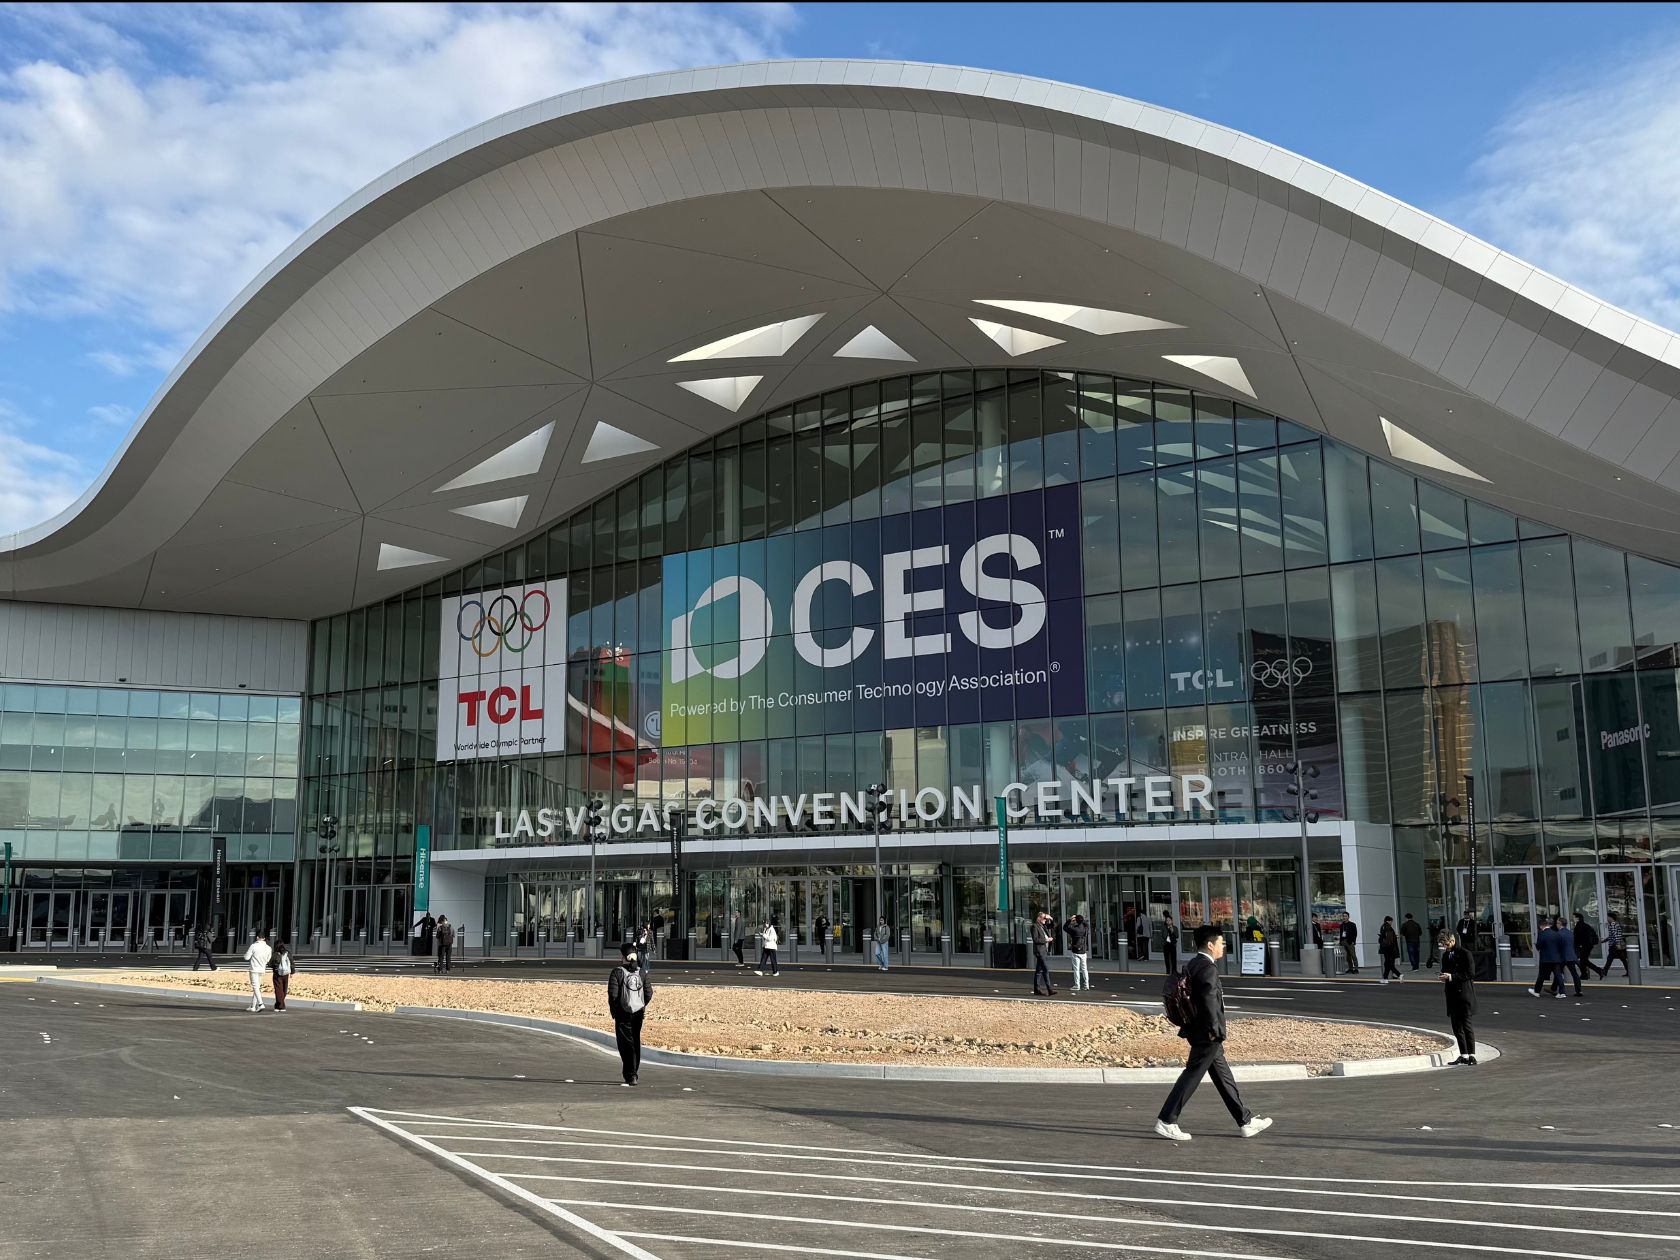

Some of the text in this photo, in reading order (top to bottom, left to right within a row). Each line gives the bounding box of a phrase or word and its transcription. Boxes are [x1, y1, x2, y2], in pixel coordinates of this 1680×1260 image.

[790, 533, 1046, 668] CES
[670, 698, 726, 718] Powered
[730, 698, 746, 714] by
[749, 695, 774, 710] The
[778, 690, 852, 707] Consumer
[856, 680, 945, 700] Technoogy
[1170, 669, 1234, 691] TCL
[458, 685, 544, 726] TCL
[1197, 749, 1295, 763] CNTRA HALL
[1198, 765, 1246, 777] BOTH
[495, 808, 554, 839] LAS
[1001, 774, 1215, 818] CENTER
[418, 848, 427, 889] Hisense
